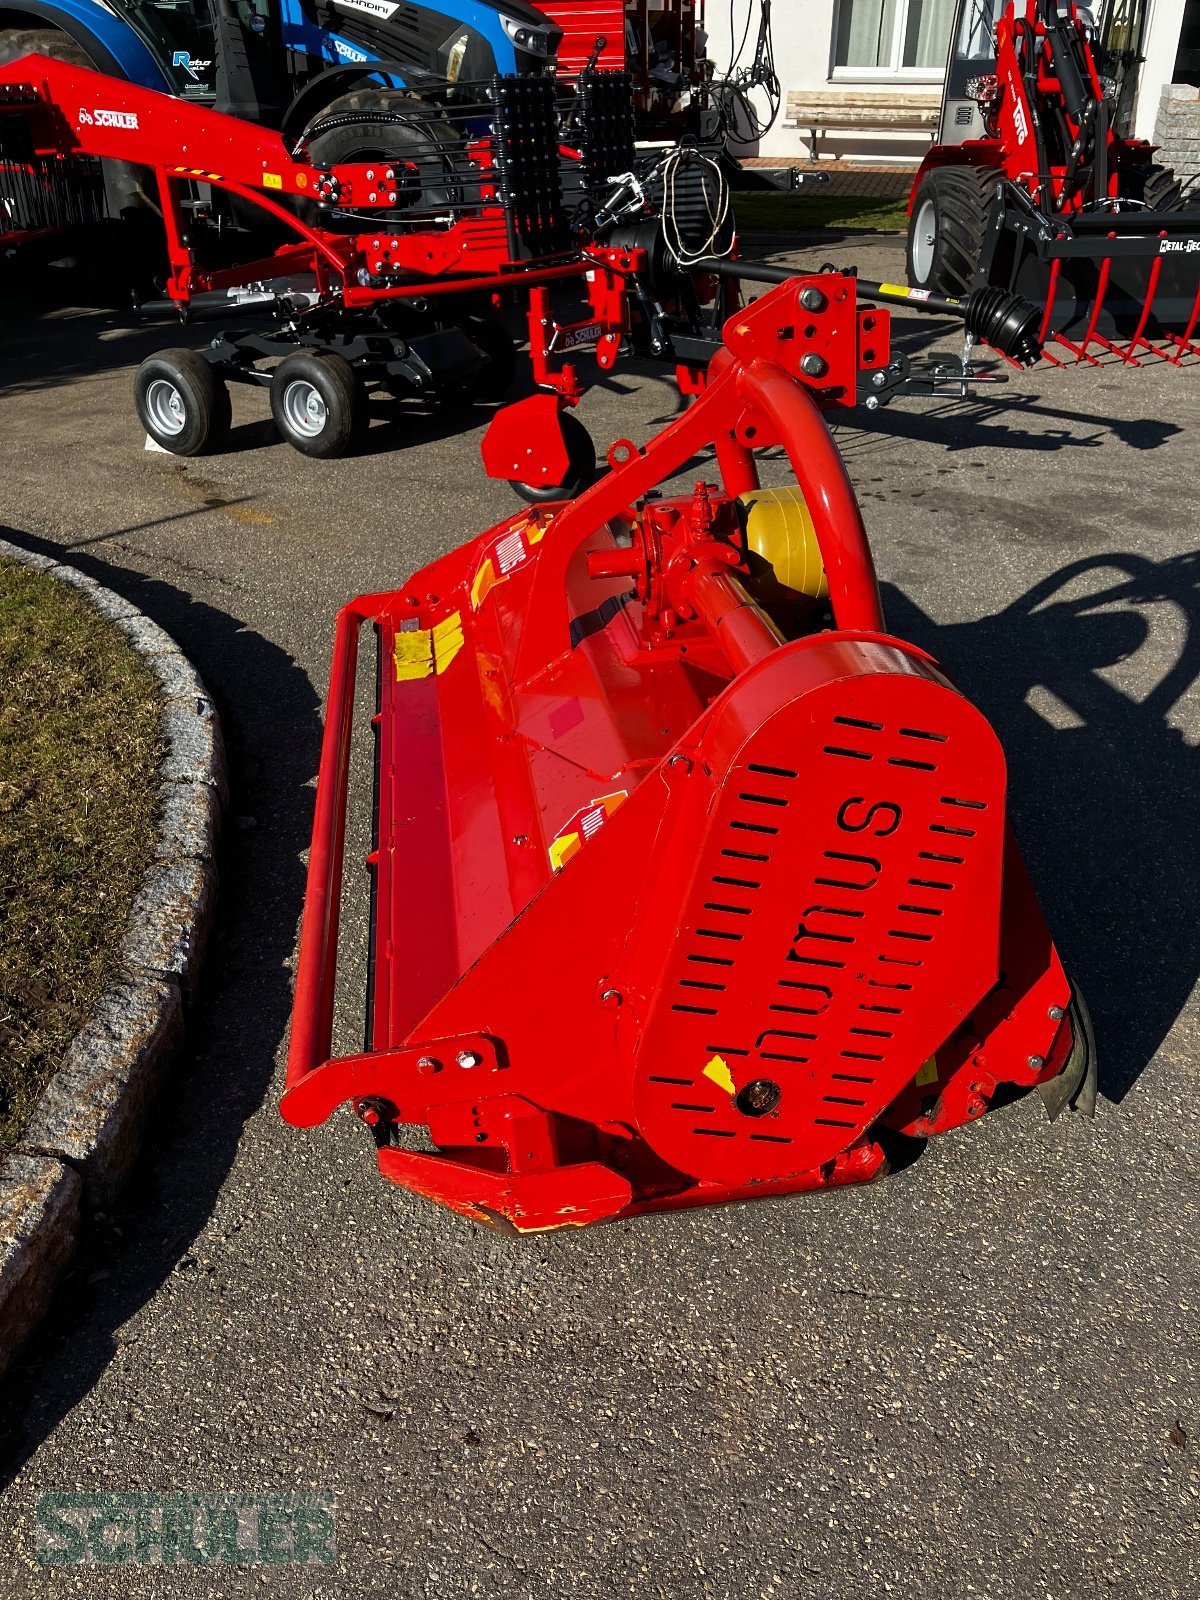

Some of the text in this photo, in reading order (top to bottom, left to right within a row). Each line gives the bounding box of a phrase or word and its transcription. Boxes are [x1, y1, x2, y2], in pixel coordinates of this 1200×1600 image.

[94, 109, 139, 130] SCHULER
[1012, 96, 1028, 146] TOYO
[575, 323, 602, 344] SCHULER
[495, 525, 526, 574] humus
[705, 796, 903, 1063] humus
